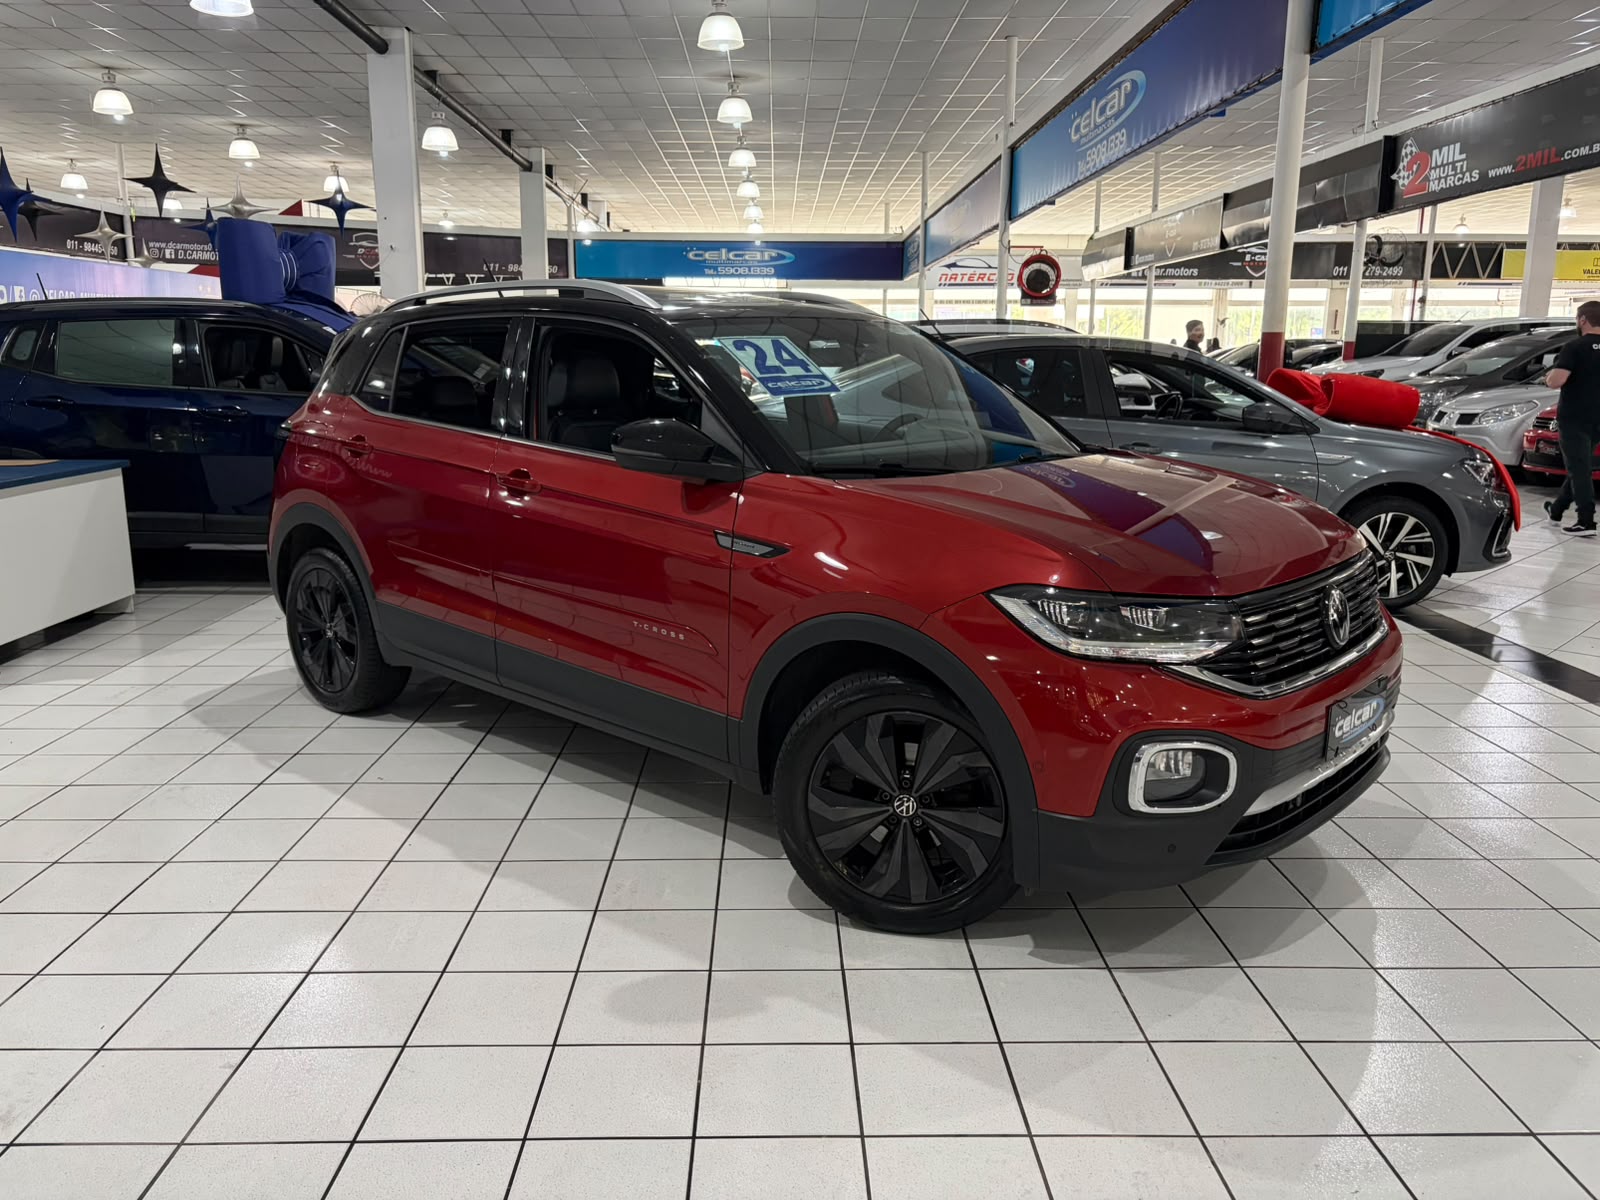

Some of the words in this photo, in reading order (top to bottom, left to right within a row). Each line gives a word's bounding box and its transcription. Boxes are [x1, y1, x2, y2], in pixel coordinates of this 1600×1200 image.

[1071, 79, 1132, 143] celcar
[1431, 142, 1467, 168] MIL
[1429, 160, 1467, 181] MULTI
[1429, 169, 1480, 193] MARCAS
[66, 239, 78, 250] 011
[83, 241, 118, 256] 98445-50
[687, 248, 778, 261] celcar
[717, 266, 775, 275] 5908.1339
[938, 271, 1015, 282] NATÉRCO
[1332, 265, 1348, 276] 011
[732, 340, 813, 374] 24
[768, 380, 820, 389] celcar
[633, 621, 686, 641] T-CROSS
[1334, 700, 1377, 738] celcar
